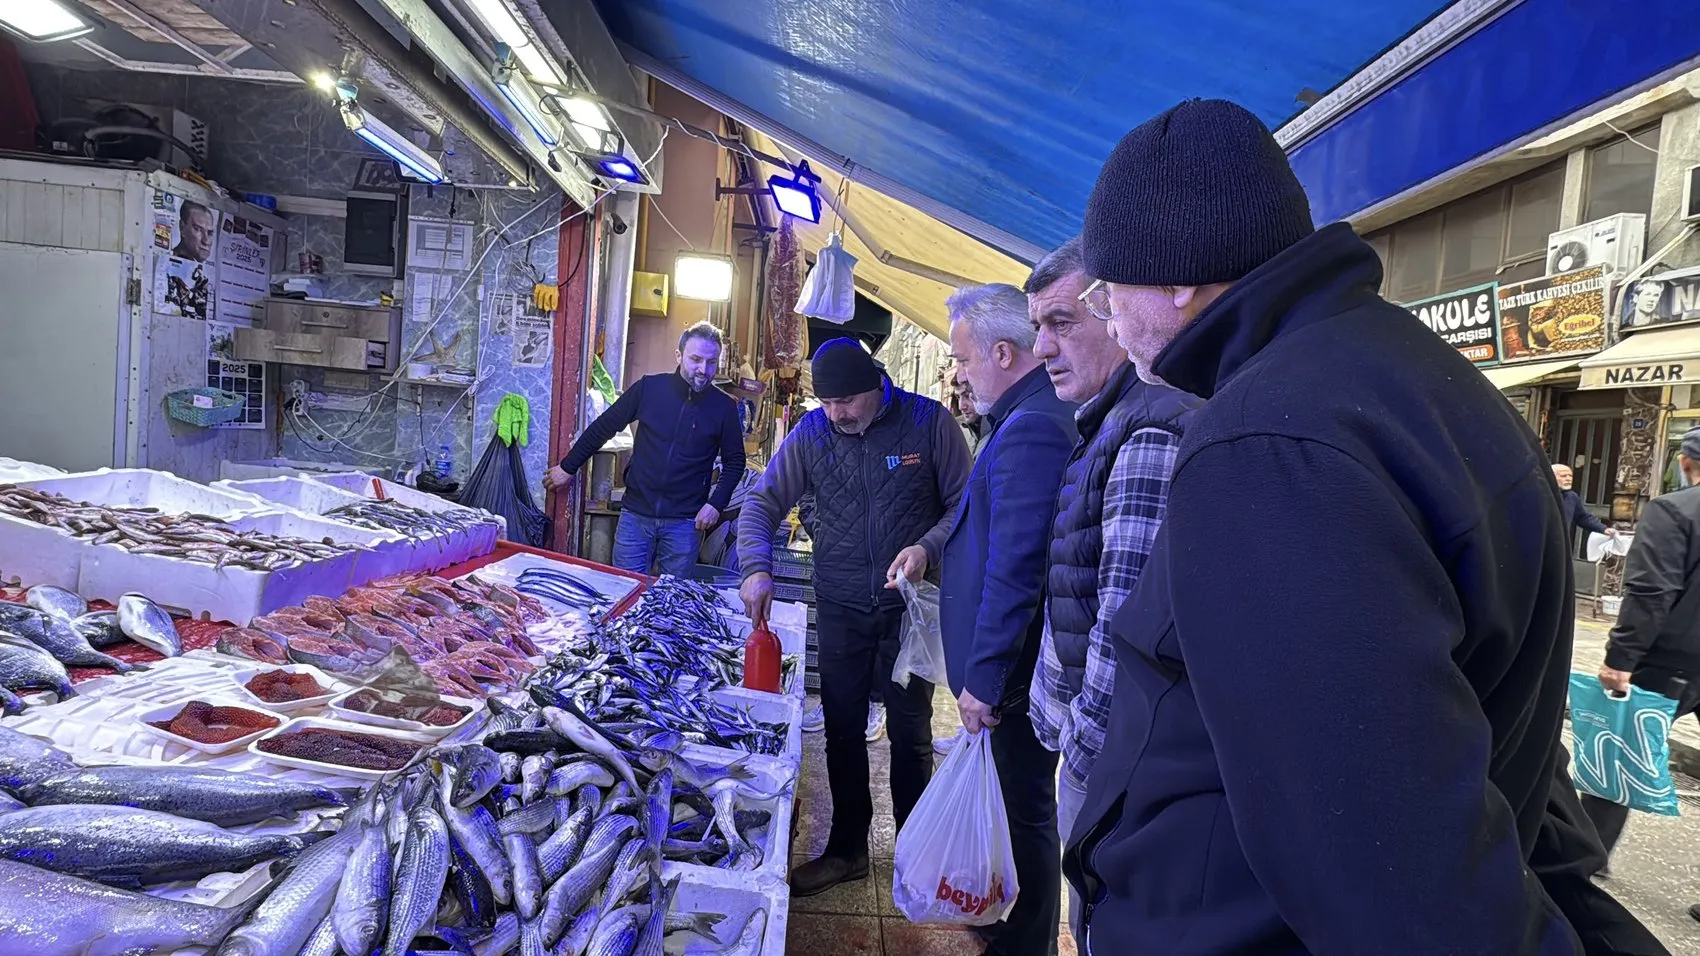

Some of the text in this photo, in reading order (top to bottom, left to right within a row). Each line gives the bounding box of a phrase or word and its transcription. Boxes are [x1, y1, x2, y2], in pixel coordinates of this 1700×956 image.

[1499, 296, 1516, 311] TAZE
[1516, 289, 1537, 307] TÜRK
[1536, 282, 1571, 302] KAHVESİ
[1411, 294, 1490, 333] AKULE
[222, 363, 247, 374] 2025
[1605, 364, 1684, 385] NAZAR
